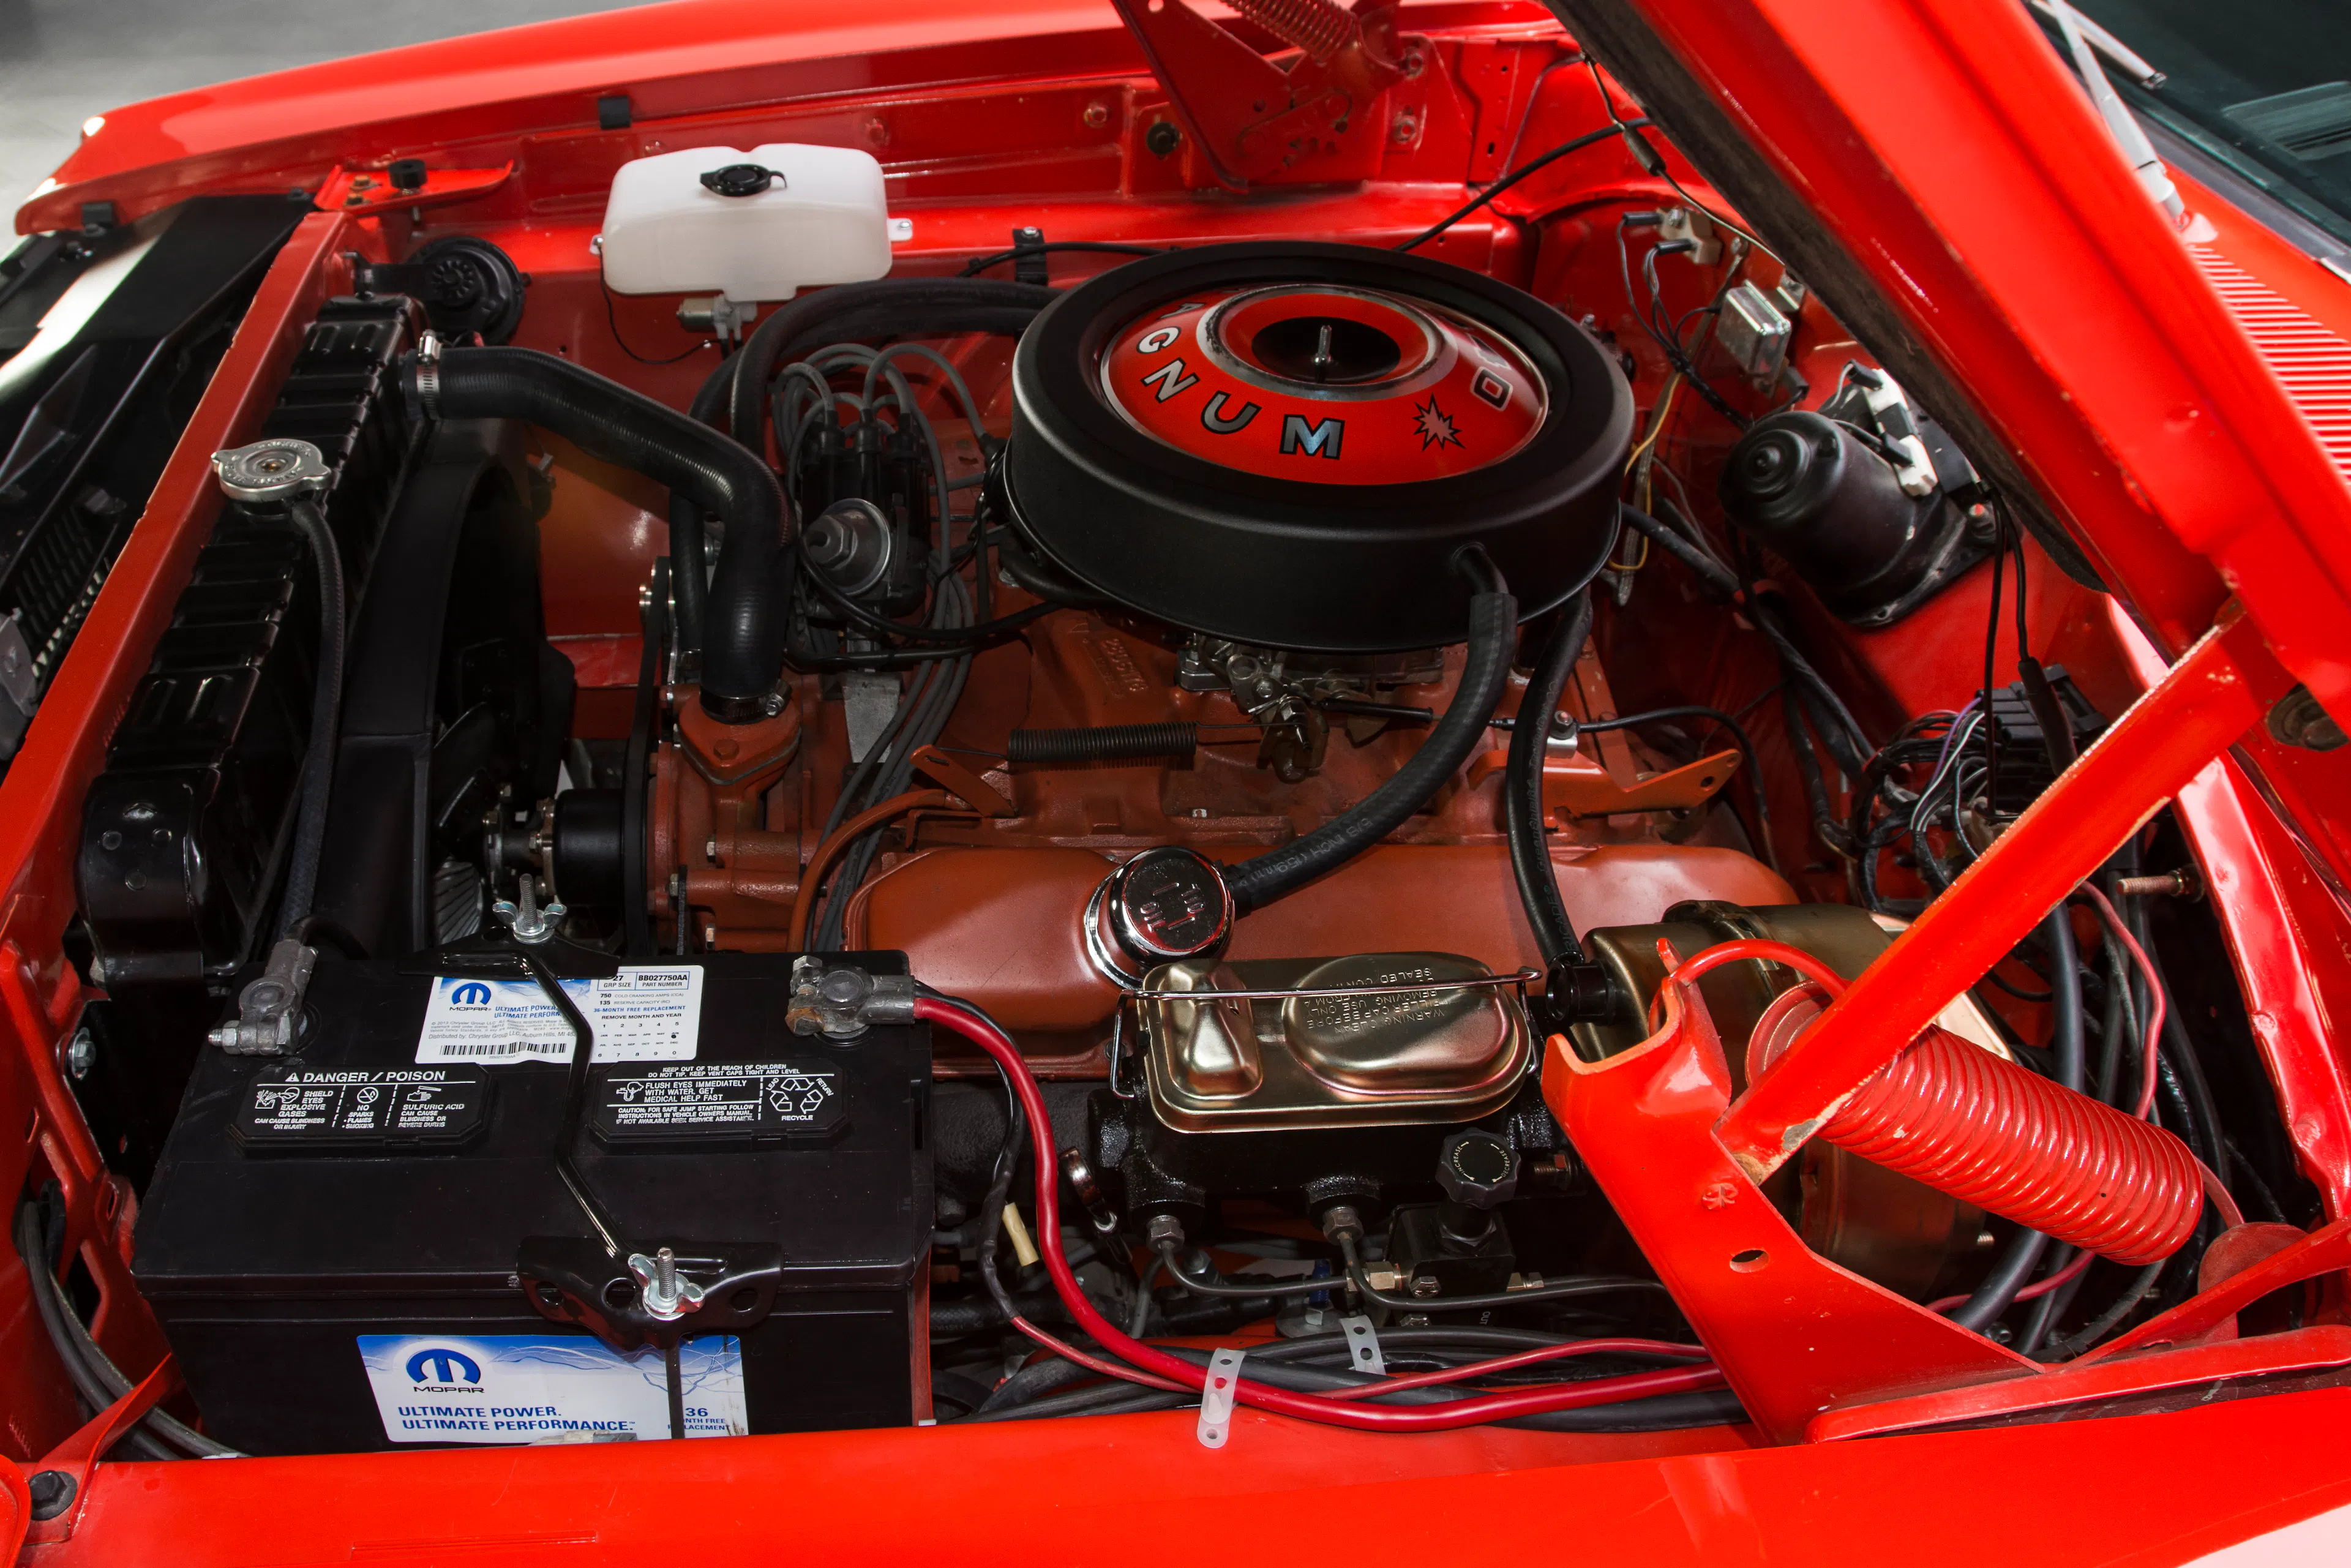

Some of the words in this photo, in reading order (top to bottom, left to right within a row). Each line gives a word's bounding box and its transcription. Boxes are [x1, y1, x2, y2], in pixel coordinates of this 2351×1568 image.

[1310, 834, 1345, 858] INCH
[1543, 885, 1573, 951] RICADE®
[1379, 967, 1431, 983] SEALED
[1303, 1005, 1336, 1018] ONLY
[1341, 999, 1367, 1011] USE
[1363, 1005, 1389, 1018] CAP
[1392, 999, 1439, 1013] FILLER
[1306, 1010, 1360, 1029] BEFORE
[1384, 1009, 1444, 1025] WARNING
[1333, 1019, 1376, 1033] CLEAN
[303, 1072, 369, 1082] DANGER
[386, 1071, 445, 1081] POISON
[766, 1078, 779, 1091] LEAD
[816, 1078, 834, 1097] RETURN
[644, 1095, 677, 1104] MEDICAL
[681, 1095, 700, 1103] HELP
[1453, 1146, 1465, 1174] INCREASE
[1499, 1150, 1511, 1177] DECREASE
[1479, 1310, 1491, 1326] OUT
[399, 1406, 486, 1417] ULTIMATE
[491, 1406, 561, 1417] POWER.
[686, 1408, 708, 1417] 36
[403, 1420, 490, 1430] ULTIMATE
